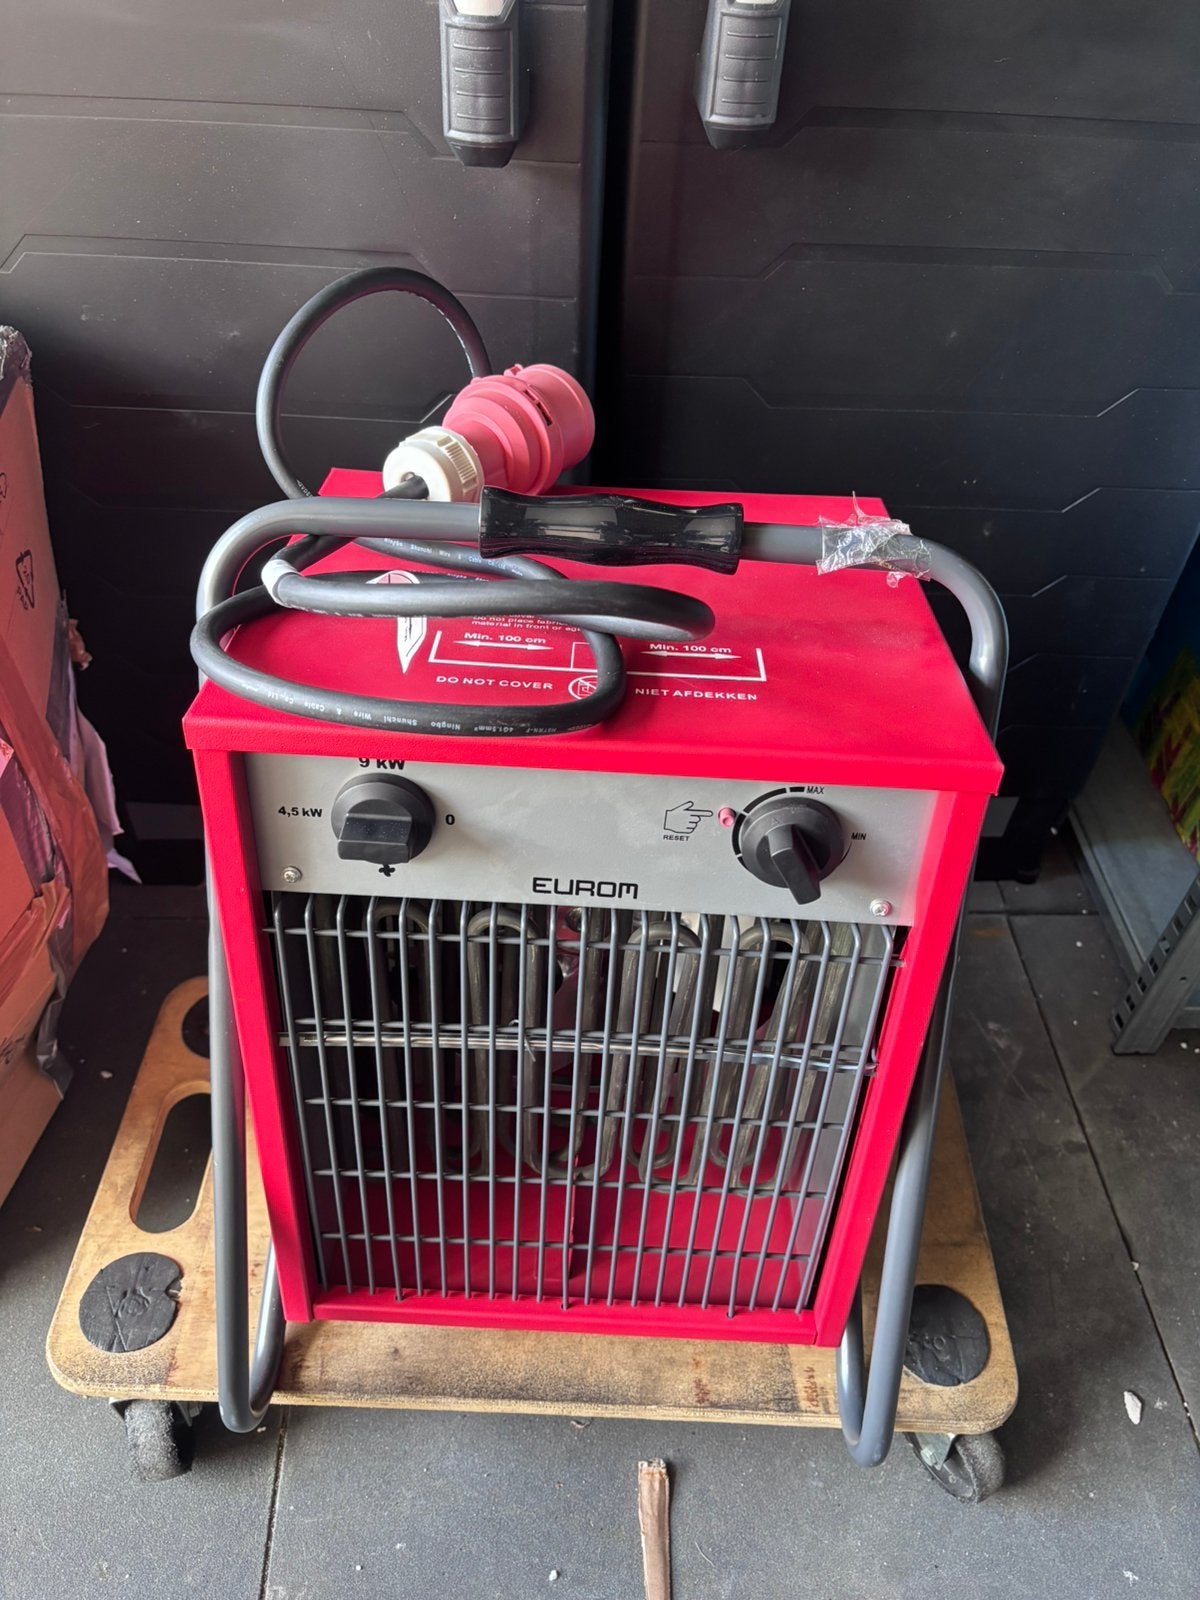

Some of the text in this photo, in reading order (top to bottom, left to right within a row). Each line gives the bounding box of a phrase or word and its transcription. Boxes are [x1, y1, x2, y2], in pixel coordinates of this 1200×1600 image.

[471, 620, 512, 628] material
[526, 623, 549, 631] front
[464, 632, 547, 645] Min. 100 cm
[649, 643, 679, 651] Min.
[435, 675, 554, 690] DO NOT COVER
[634, 688, 758, 701] NIET AFDEKKEN
[353, 710, 372, 721] Wire
[382, 715, 418, 727] Shunchi
[430, 720, 462, 731] Ningbo
[358, 757, 406, 770] 9 kW
[806, 785, 825, 795] MAX
[277, 805, 323, 818] 4,5 kW
[445, 813, 456, 826] 0
[662, 834, 691, 842] RESET
[850, 832, 867, 842] MIN
[531, 876, 639, 900] EUROM
